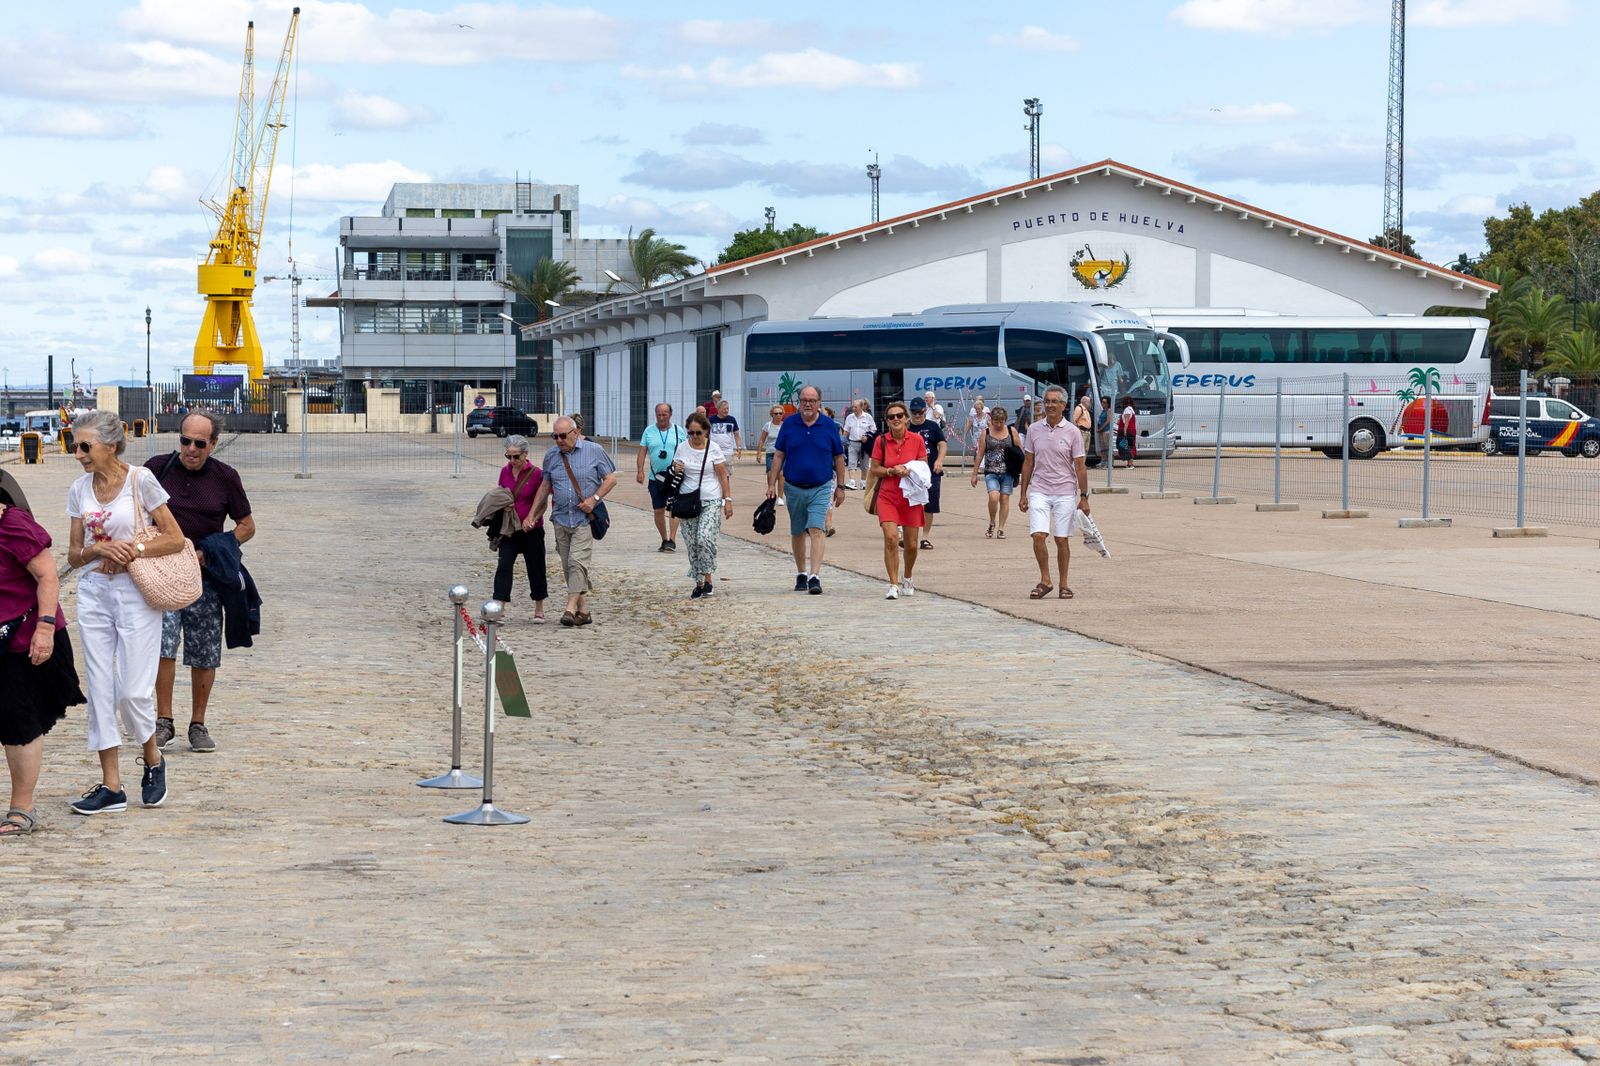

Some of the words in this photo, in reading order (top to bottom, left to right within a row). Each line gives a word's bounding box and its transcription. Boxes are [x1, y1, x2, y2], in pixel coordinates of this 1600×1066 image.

[1013, 212, 1079, 231] PUERTO
[1090, 211, 1109, 222] DE
[1119, 212, 1185, 234] HUELVA
[914, 375, 987, 392] LEPEBUS
